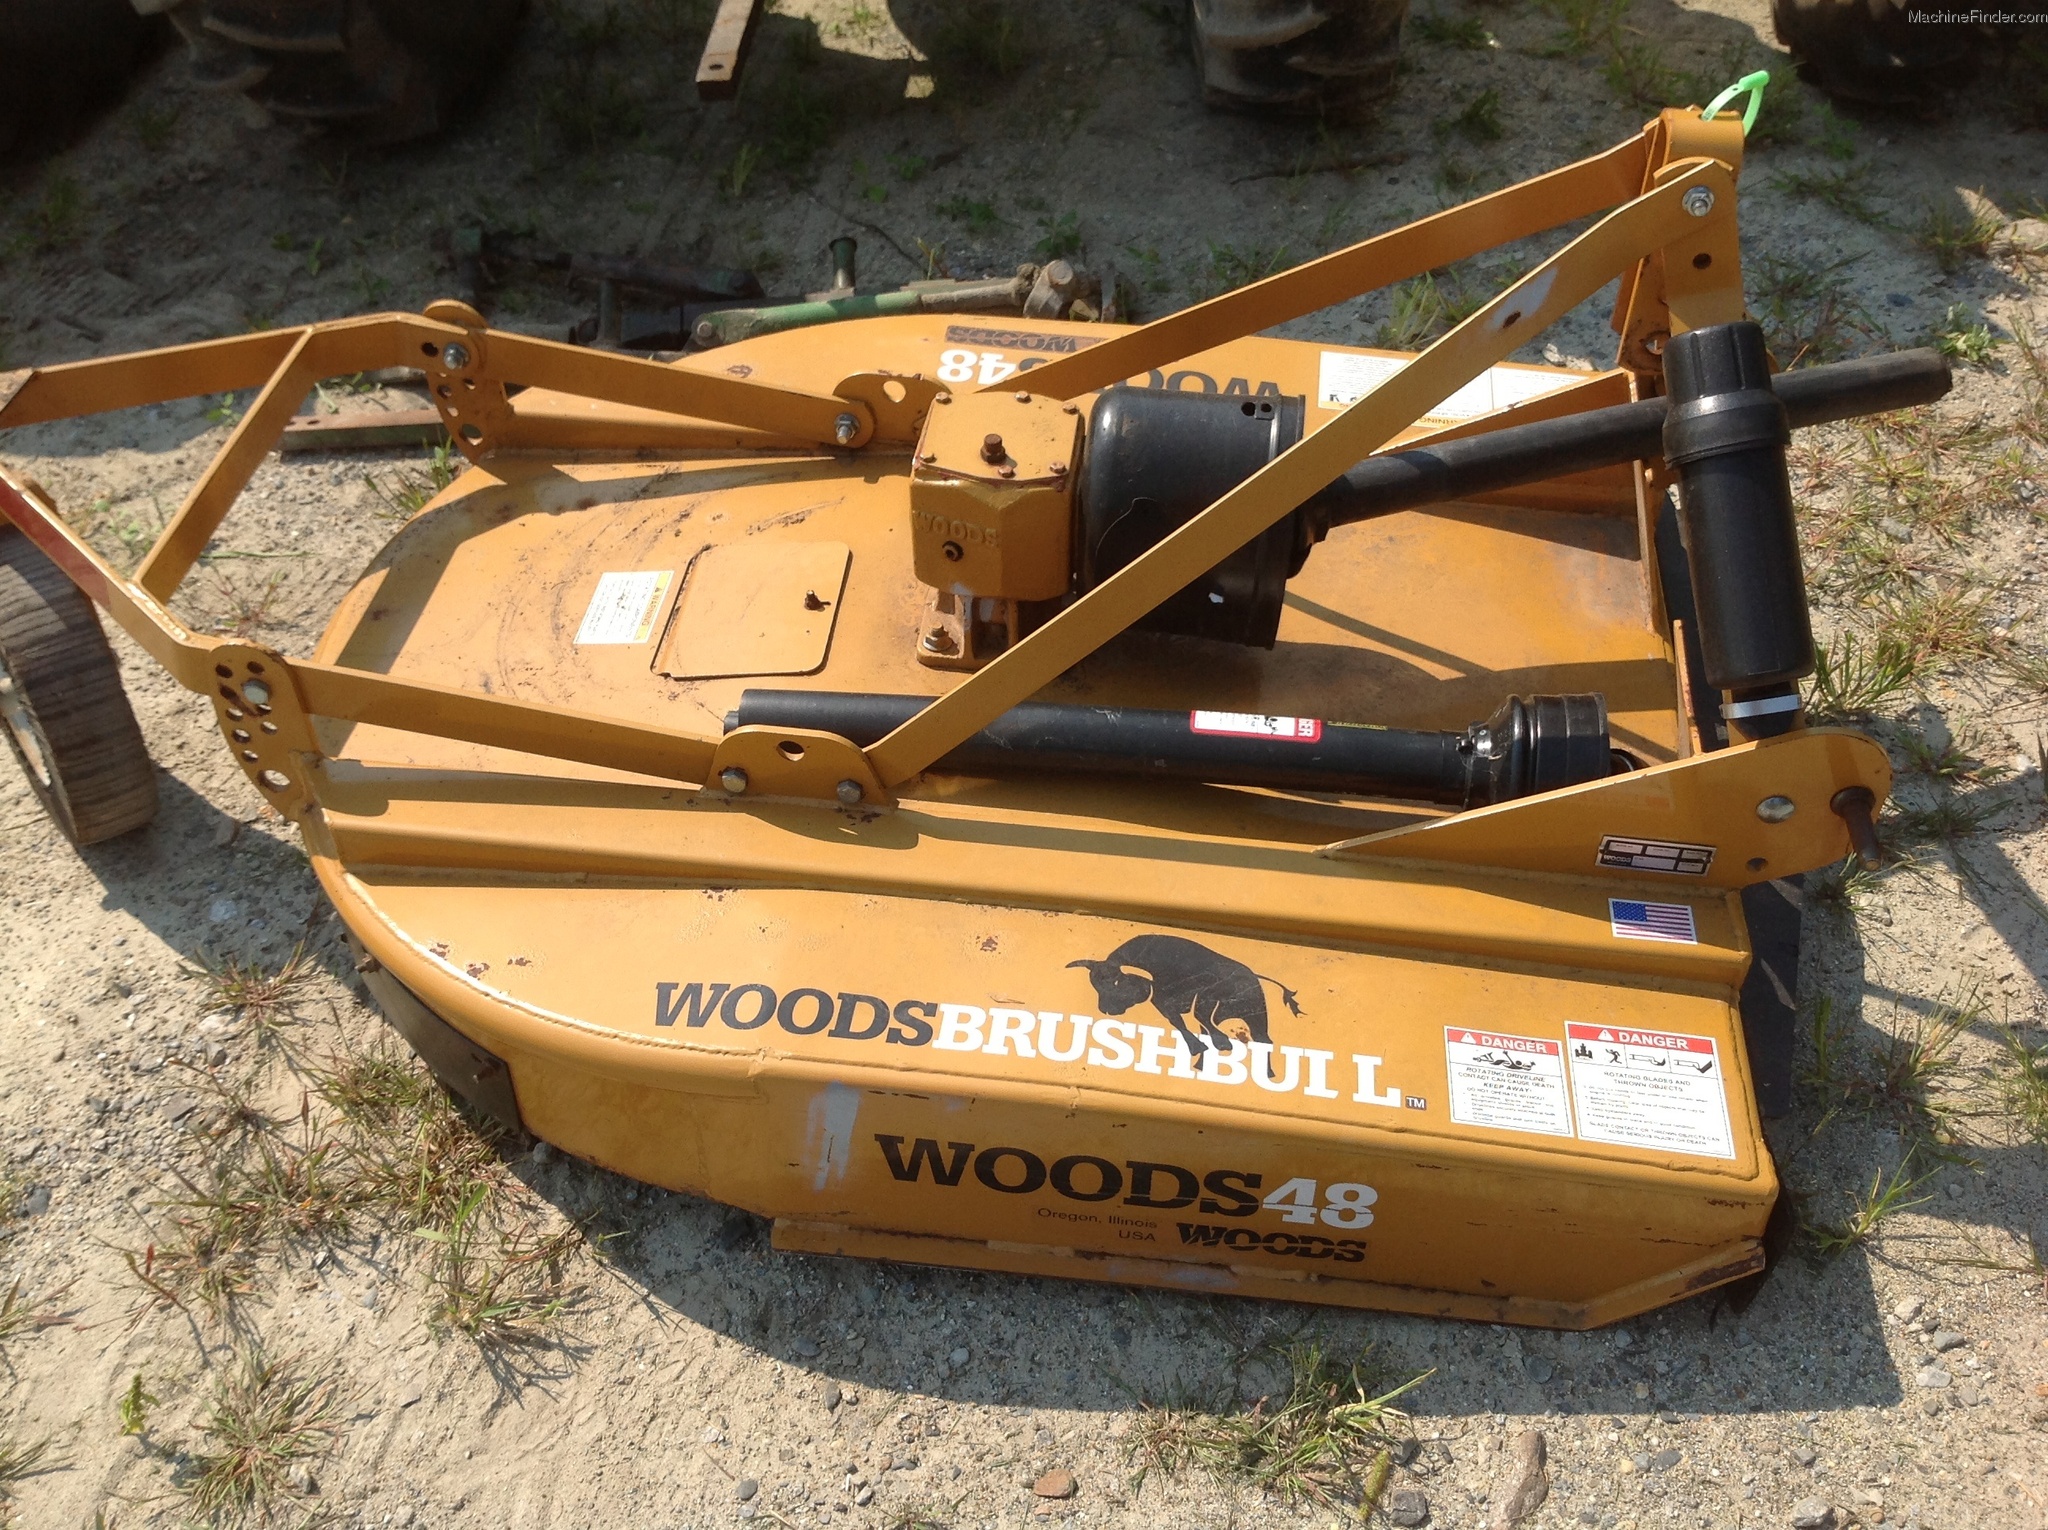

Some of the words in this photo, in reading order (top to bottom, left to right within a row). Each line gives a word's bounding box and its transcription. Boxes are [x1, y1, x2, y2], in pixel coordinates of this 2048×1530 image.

[937, 350, 1017, 385] 48
[1481, 1035, 1548, 1054] DANGER
[1618, 1032, 1689, 1050] DANGER
[1037, 1207, 1102, 1224] Oregon,
[1108, 1215, 1158, 1229] Illinois
[1118, 1229, 1157, 1241] USA
[1175, 1222, 1368, 1263] WOODS
